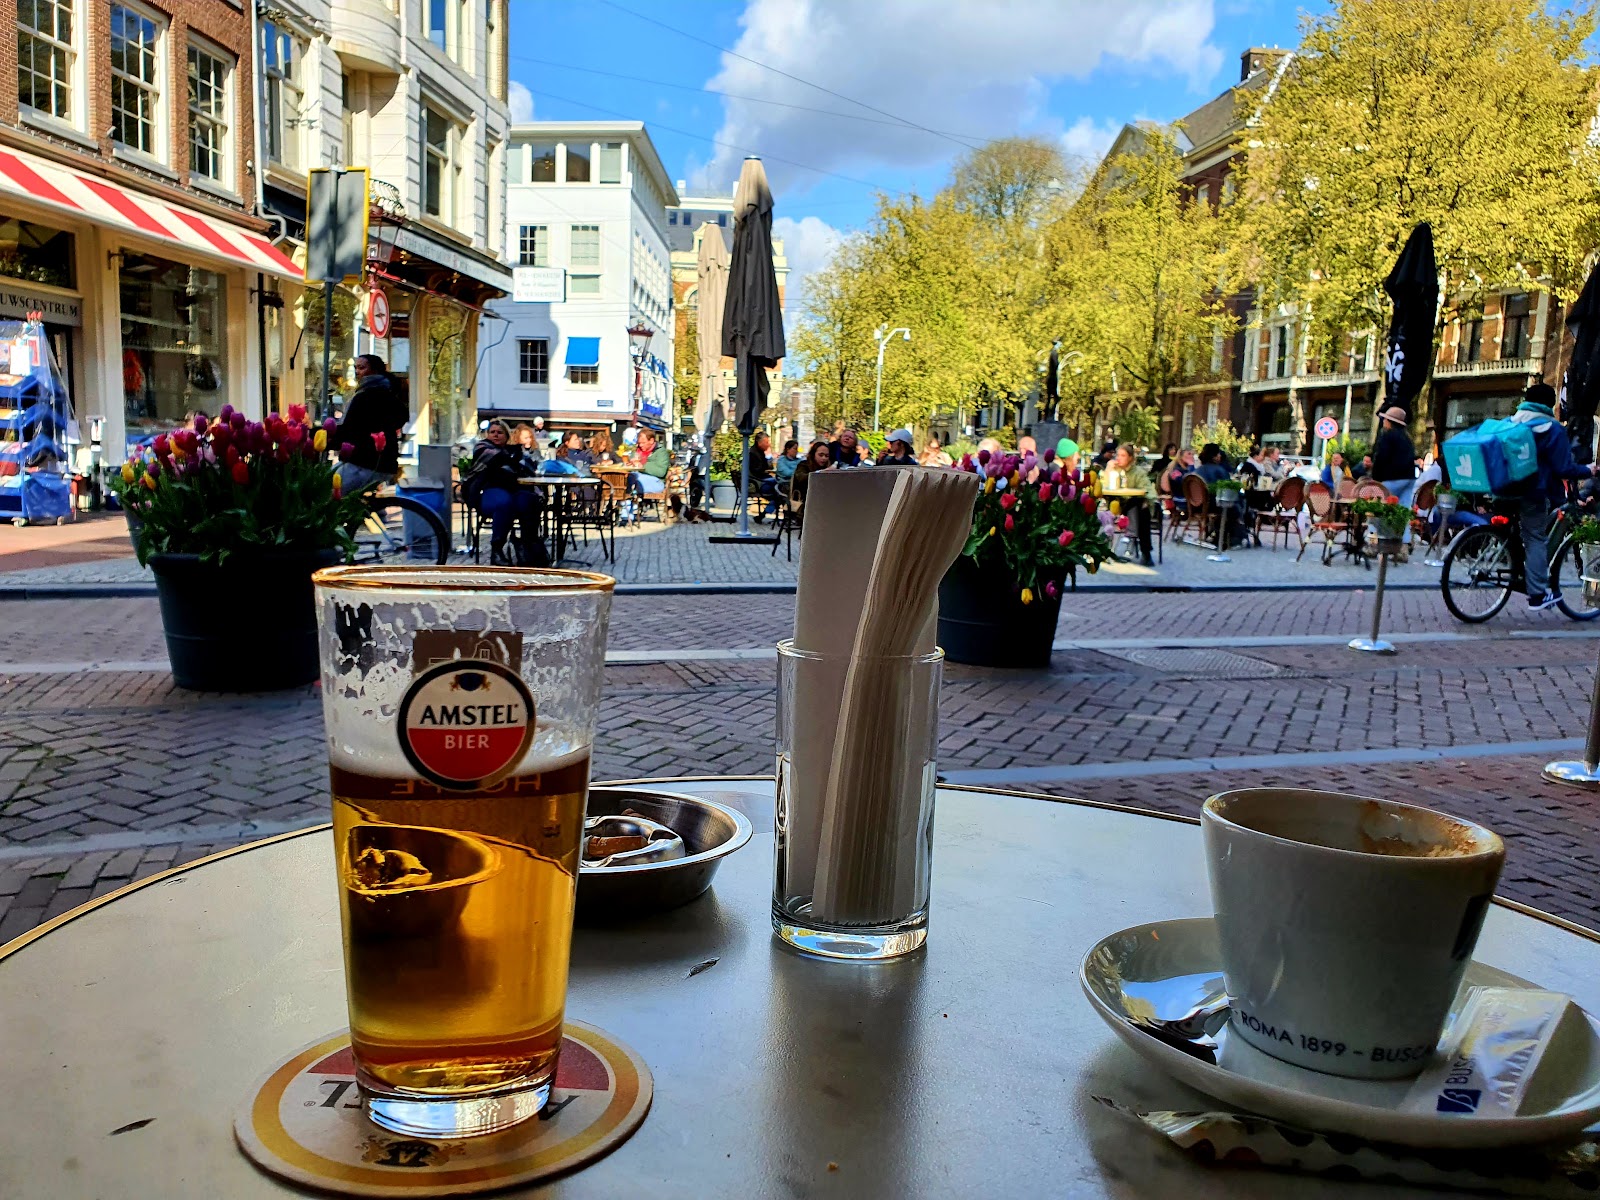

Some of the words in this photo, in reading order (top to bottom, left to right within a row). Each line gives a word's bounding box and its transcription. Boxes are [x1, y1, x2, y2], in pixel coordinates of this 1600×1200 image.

[0, 292, 78, 317] UWSCENTRUM
[419, 704, 518, 726] AMSTEL
[444, 734, 490, 749] BIER
[1240, 1009, 1294, 1046] ROMA
[1300, 1034, 1347, 1057] 1899
